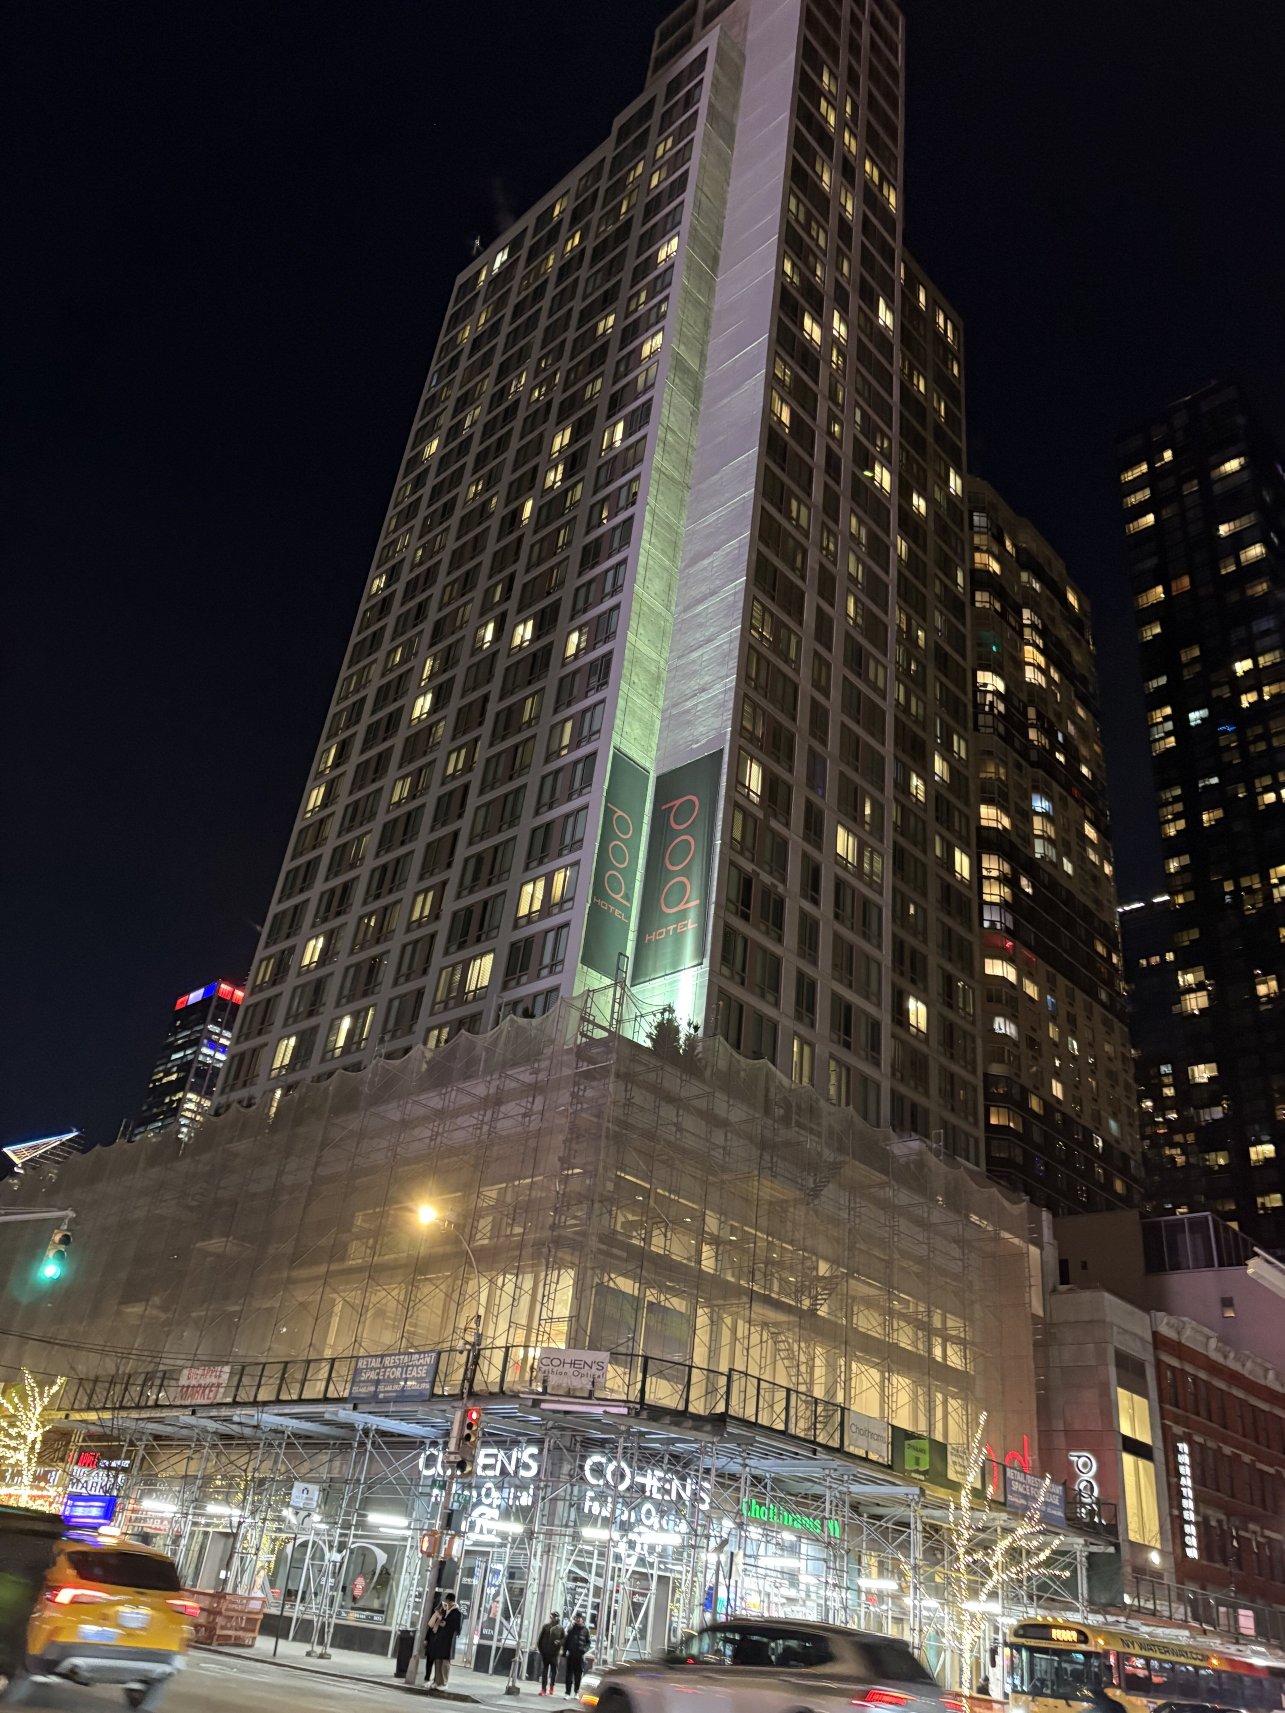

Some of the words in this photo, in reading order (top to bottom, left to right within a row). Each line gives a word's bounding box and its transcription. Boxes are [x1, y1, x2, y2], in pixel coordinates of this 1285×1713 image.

[604, 802, 633, 907] pod
[660, 794, 700, 914] pod
[593, 896, 628, 922] HOTEL
[645, 919, 698, 943] HOTEL
[360, 1369, 384, 1380] SPACE
[384, 1368, 401, 1379] FOR
[402, 1366, 428, 1378] LEASE
[539, 1367, 568, 1376] Fashion
[572, 1370, 605, 1379] Optical
[540, 1357, 605, 1371] COHEN'S
[180, 1383, 223, 1401] MARKET
[849, 1423, 886, 1444] Choithrams
